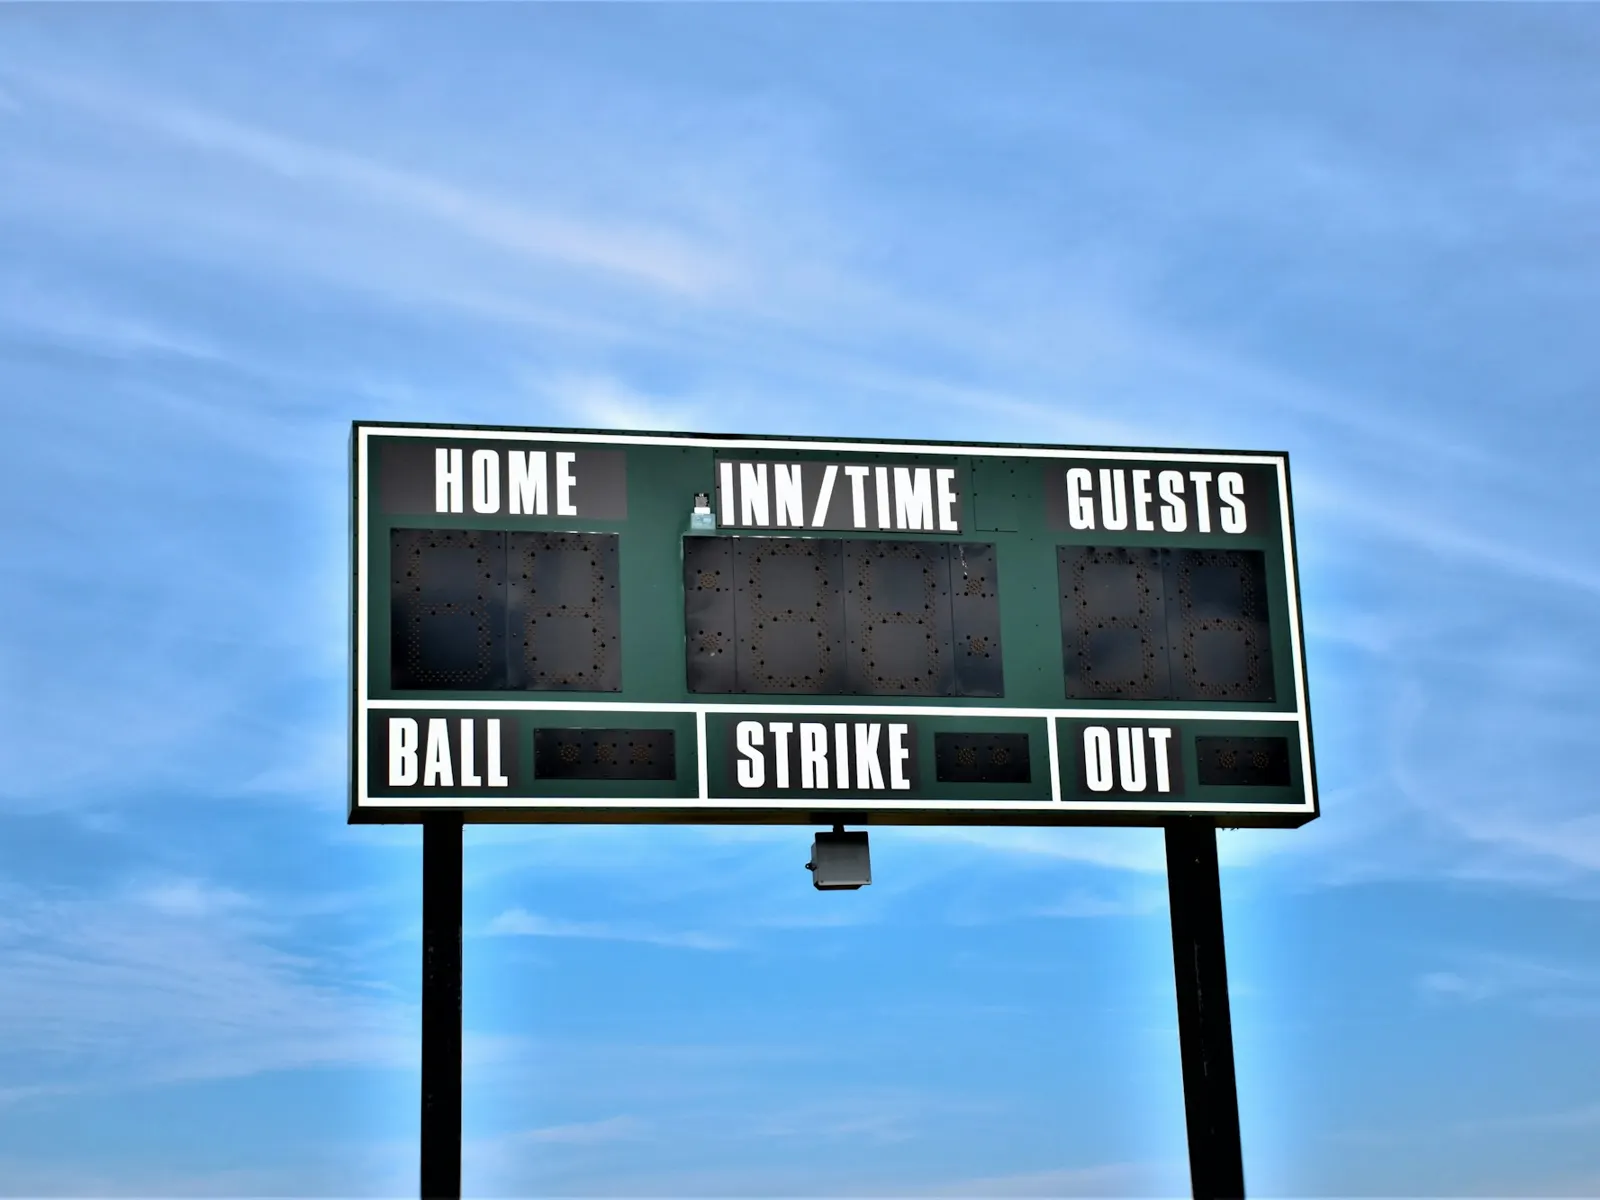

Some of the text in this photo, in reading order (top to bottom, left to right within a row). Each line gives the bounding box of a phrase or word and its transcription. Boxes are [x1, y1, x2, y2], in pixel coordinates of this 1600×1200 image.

[435, 447, 578, 516] HOME
[719, 462, 958, 532] INN/TIME
[1066, 467, 1248, 534] GUESTS
[388, 717, 508, 787] BALL
[736, 720, 911, 790] STRIKE
[1083, 726, 1173, 793] OUT
